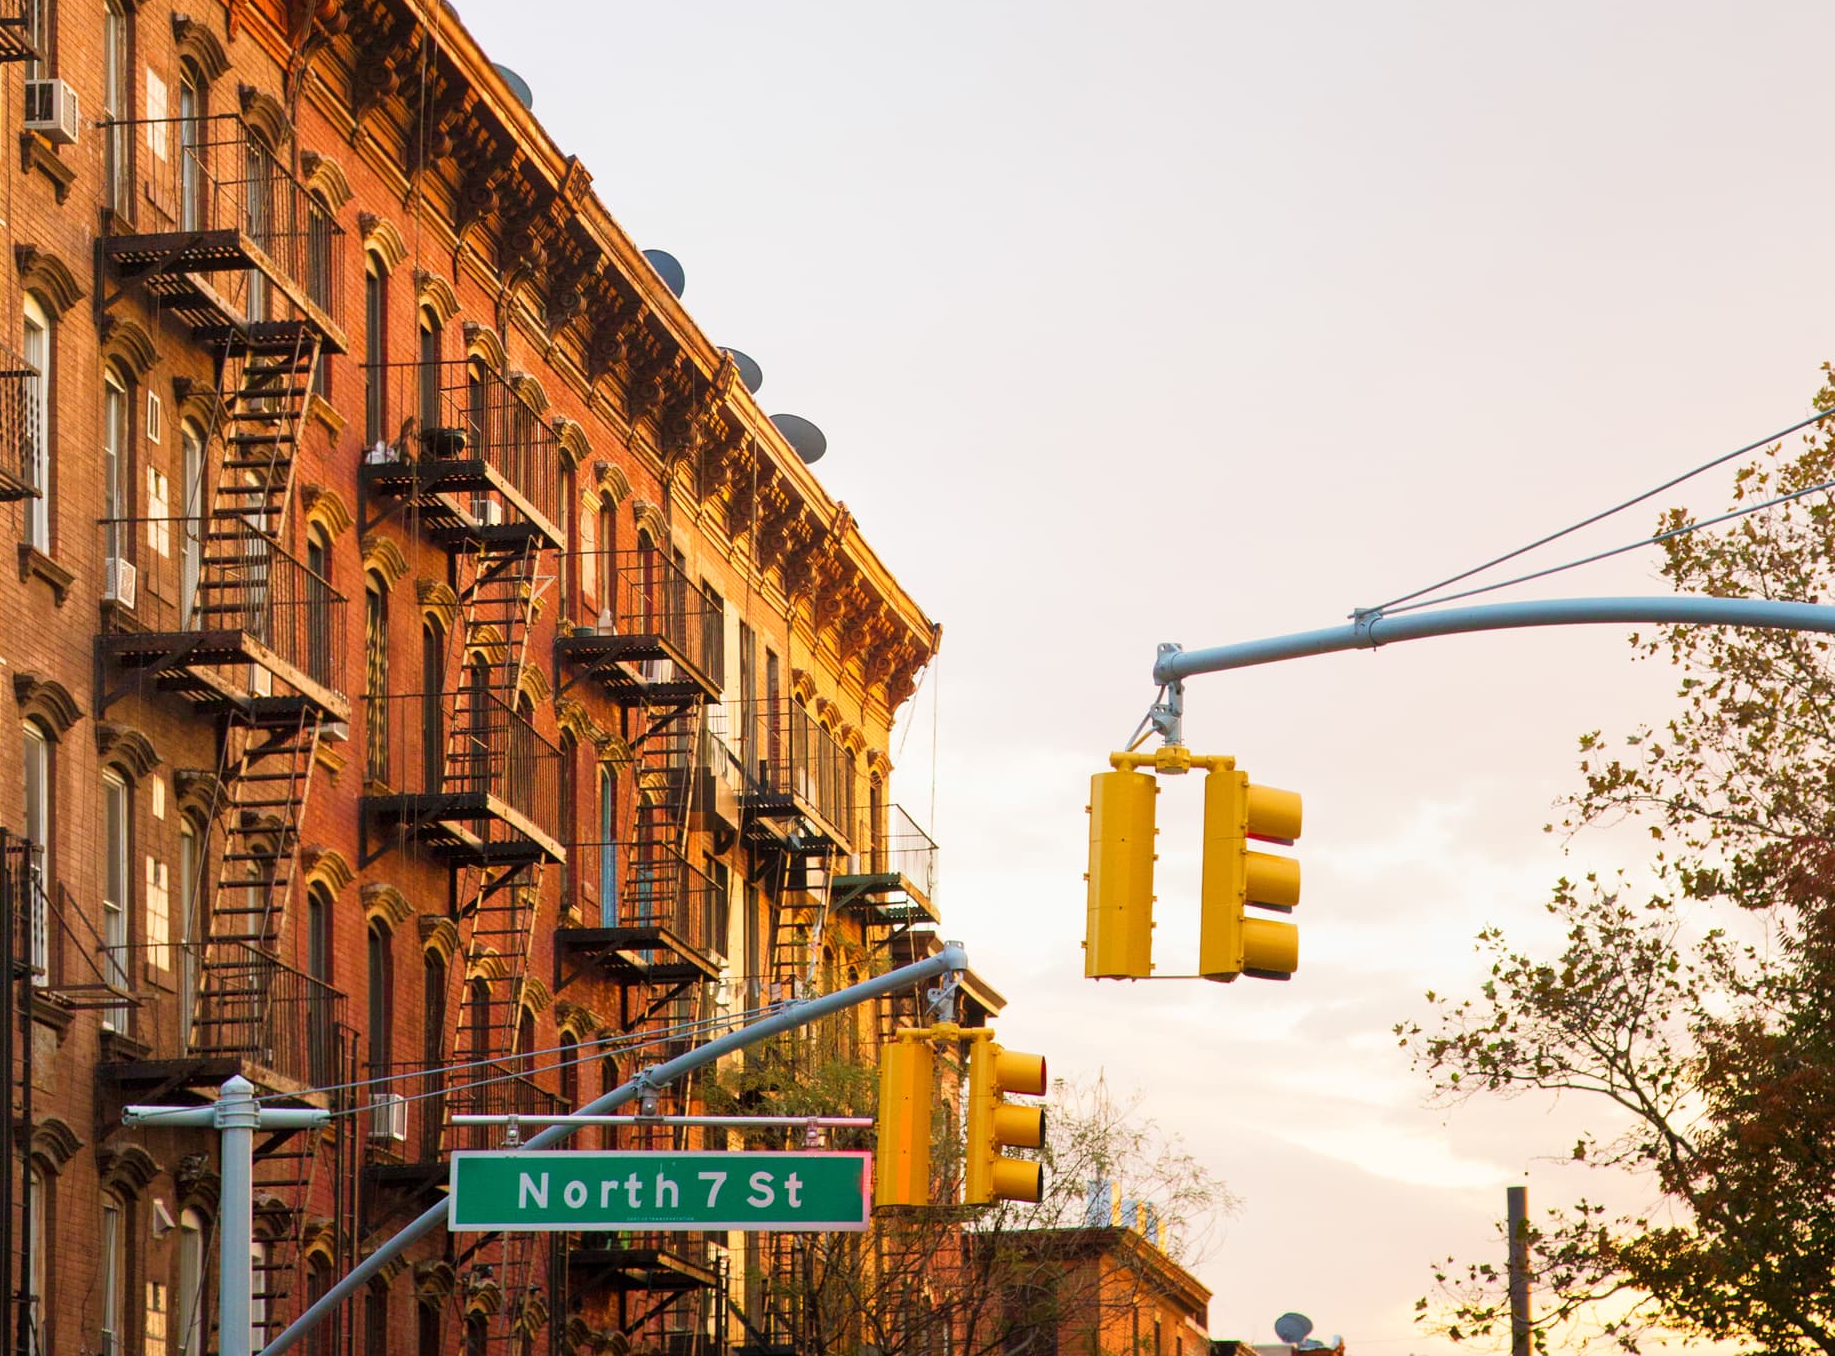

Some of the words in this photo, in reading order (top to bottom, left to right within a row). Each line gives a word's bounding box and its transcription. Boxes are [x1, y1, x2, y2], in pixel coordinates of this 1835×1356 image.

[518, 1171, 679, 1209] North
[698, 1171, 727, 1208] 7
[747, 1171, 803, 1208] St
